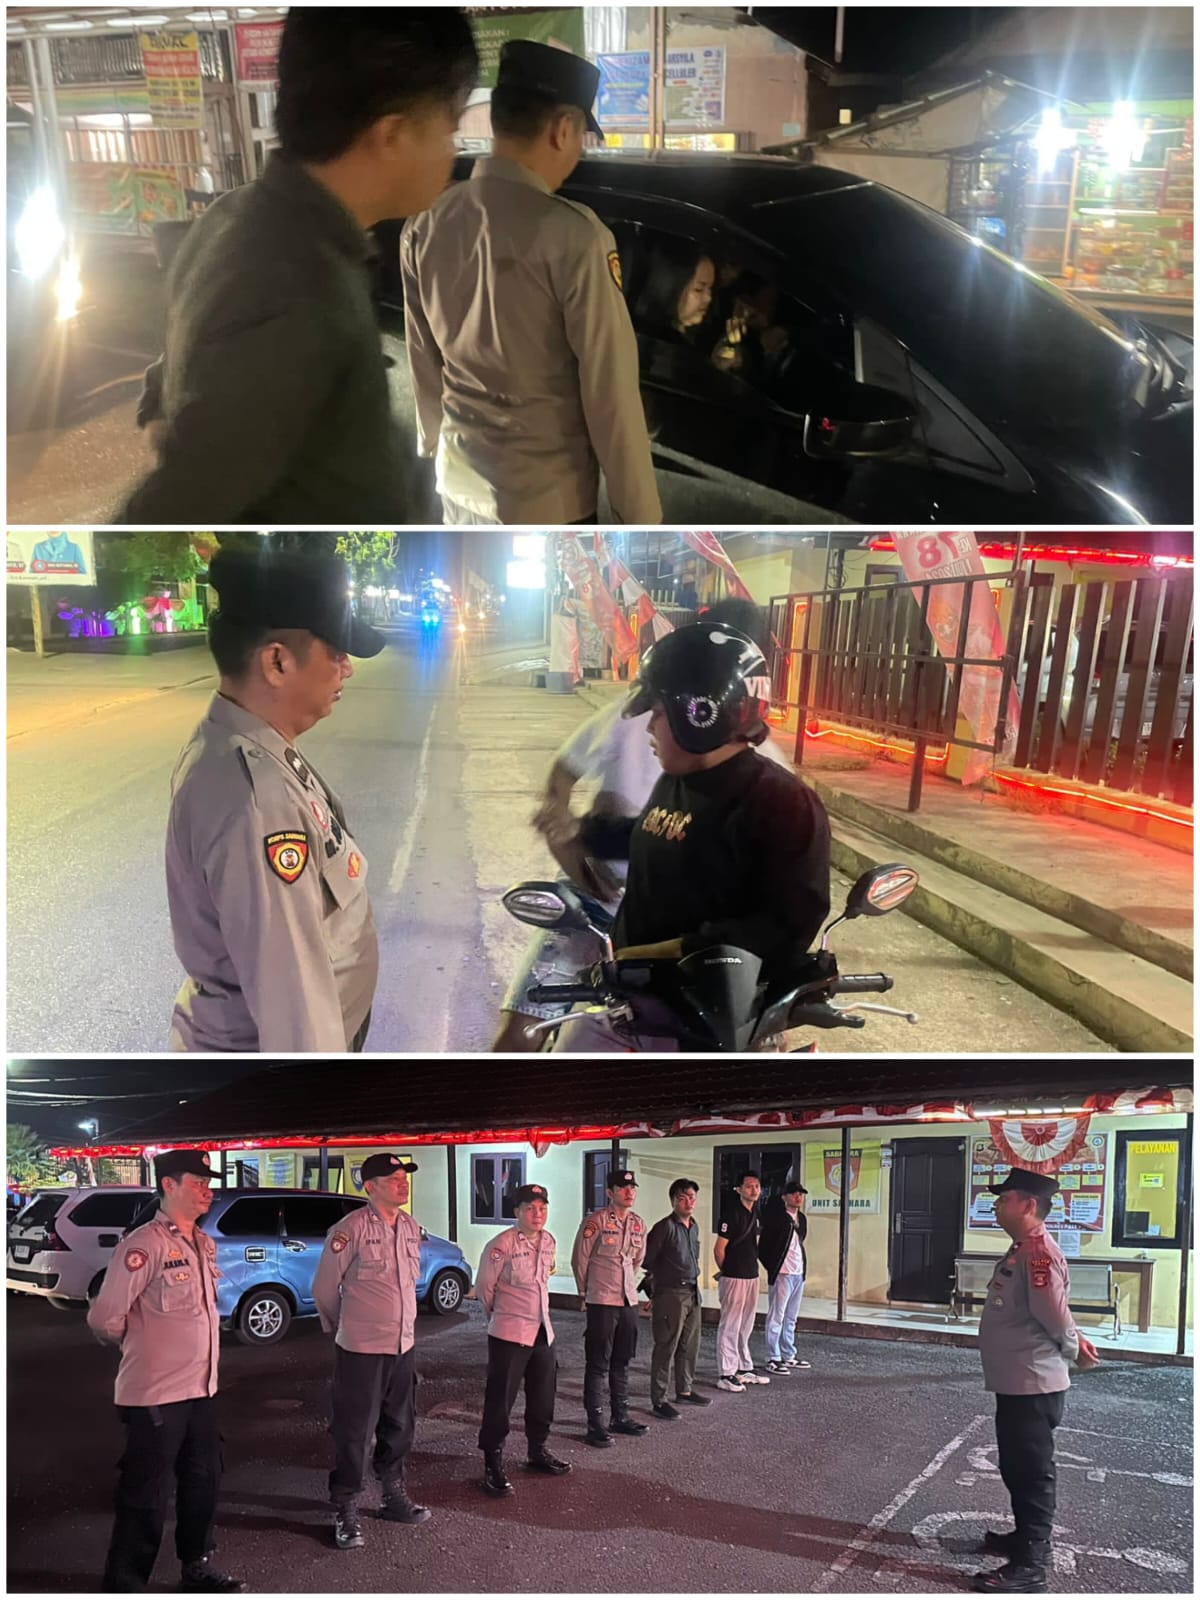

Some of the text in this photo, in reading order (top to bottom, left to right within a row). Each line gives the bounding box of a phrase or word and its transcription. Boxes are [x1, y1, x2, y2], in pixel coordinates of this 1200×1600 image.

[704, 957, 743, 965] HONDA
[1130, 1143, 1176, 1154] PELAYANAN
[721, 1222, 728, 1233] 9
